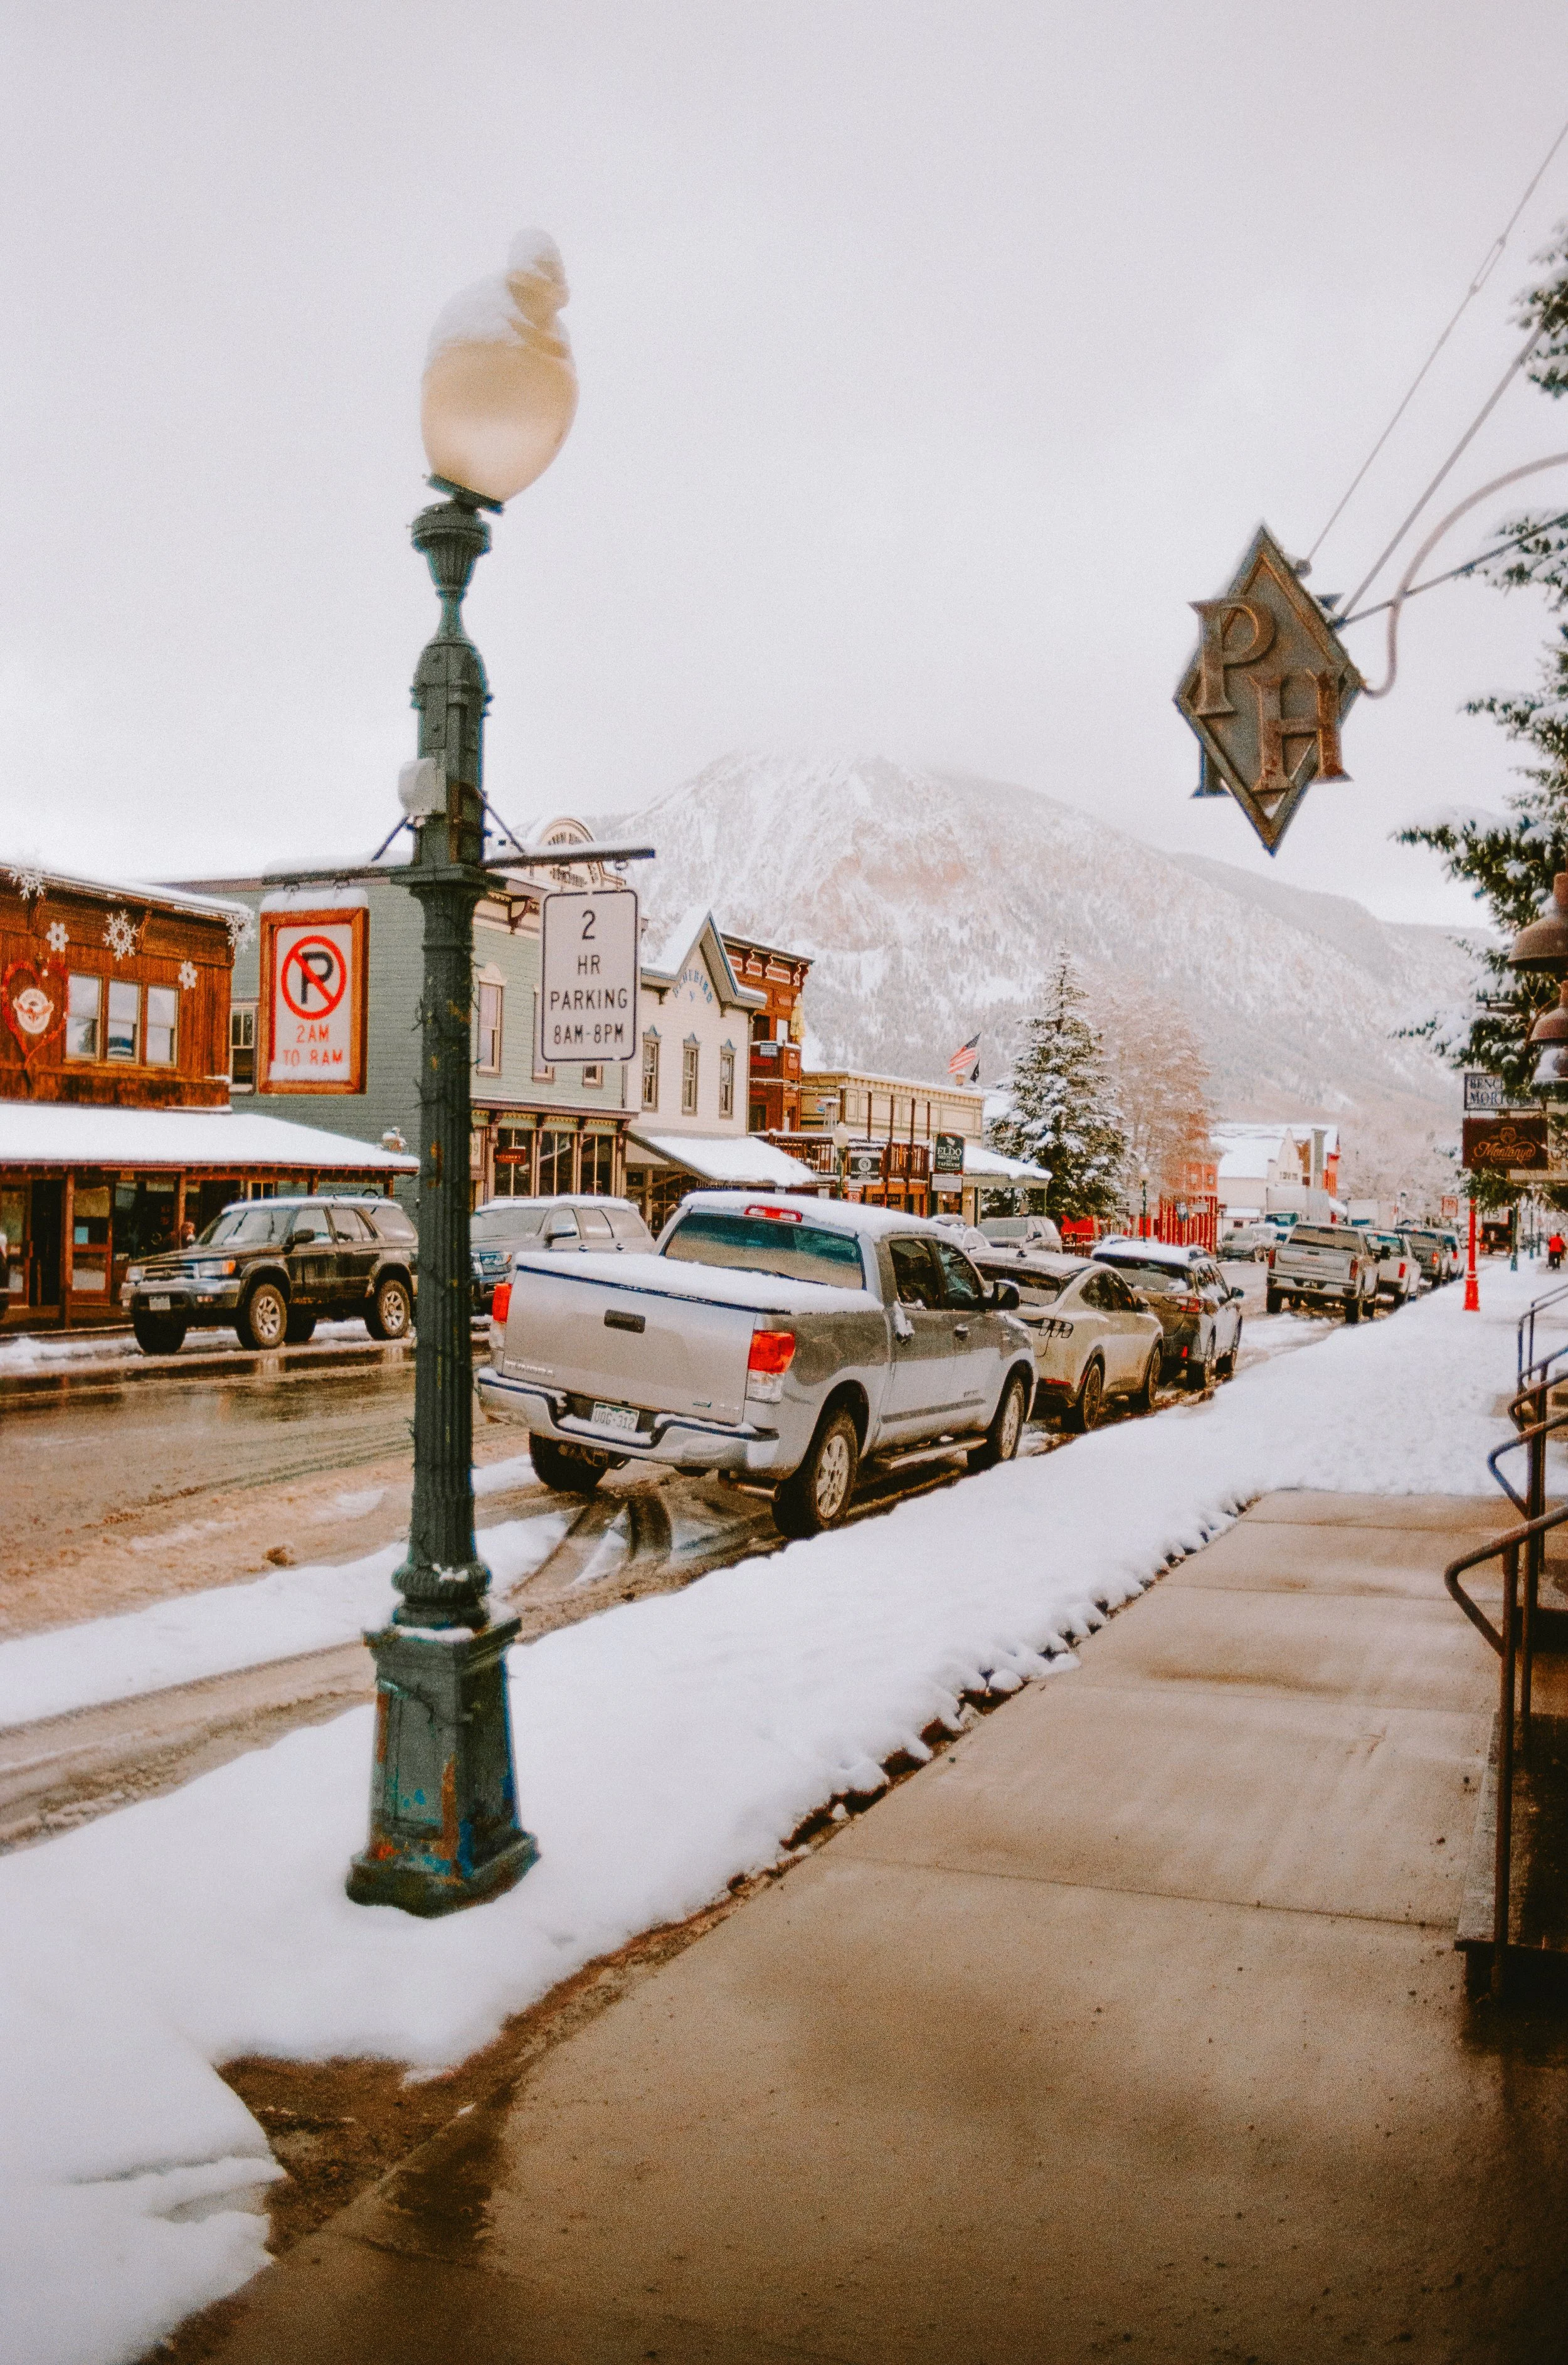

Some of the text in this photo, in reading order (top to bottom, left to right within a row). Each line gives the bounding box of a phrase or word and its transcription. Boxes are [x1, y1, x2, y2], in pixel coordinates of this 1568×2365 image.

[581, 909, 596, 940] 2
[577, 954, 600, 975] HR
[551, 987, 628, 1011] PARKING
[295, 1024, 329, 1043] 2AM
[554, 1023, 624, 1044] 8AM-8PM
[283, 1049, 301, 1066] TO
[937, 1146, 962, 1156] ELDO
